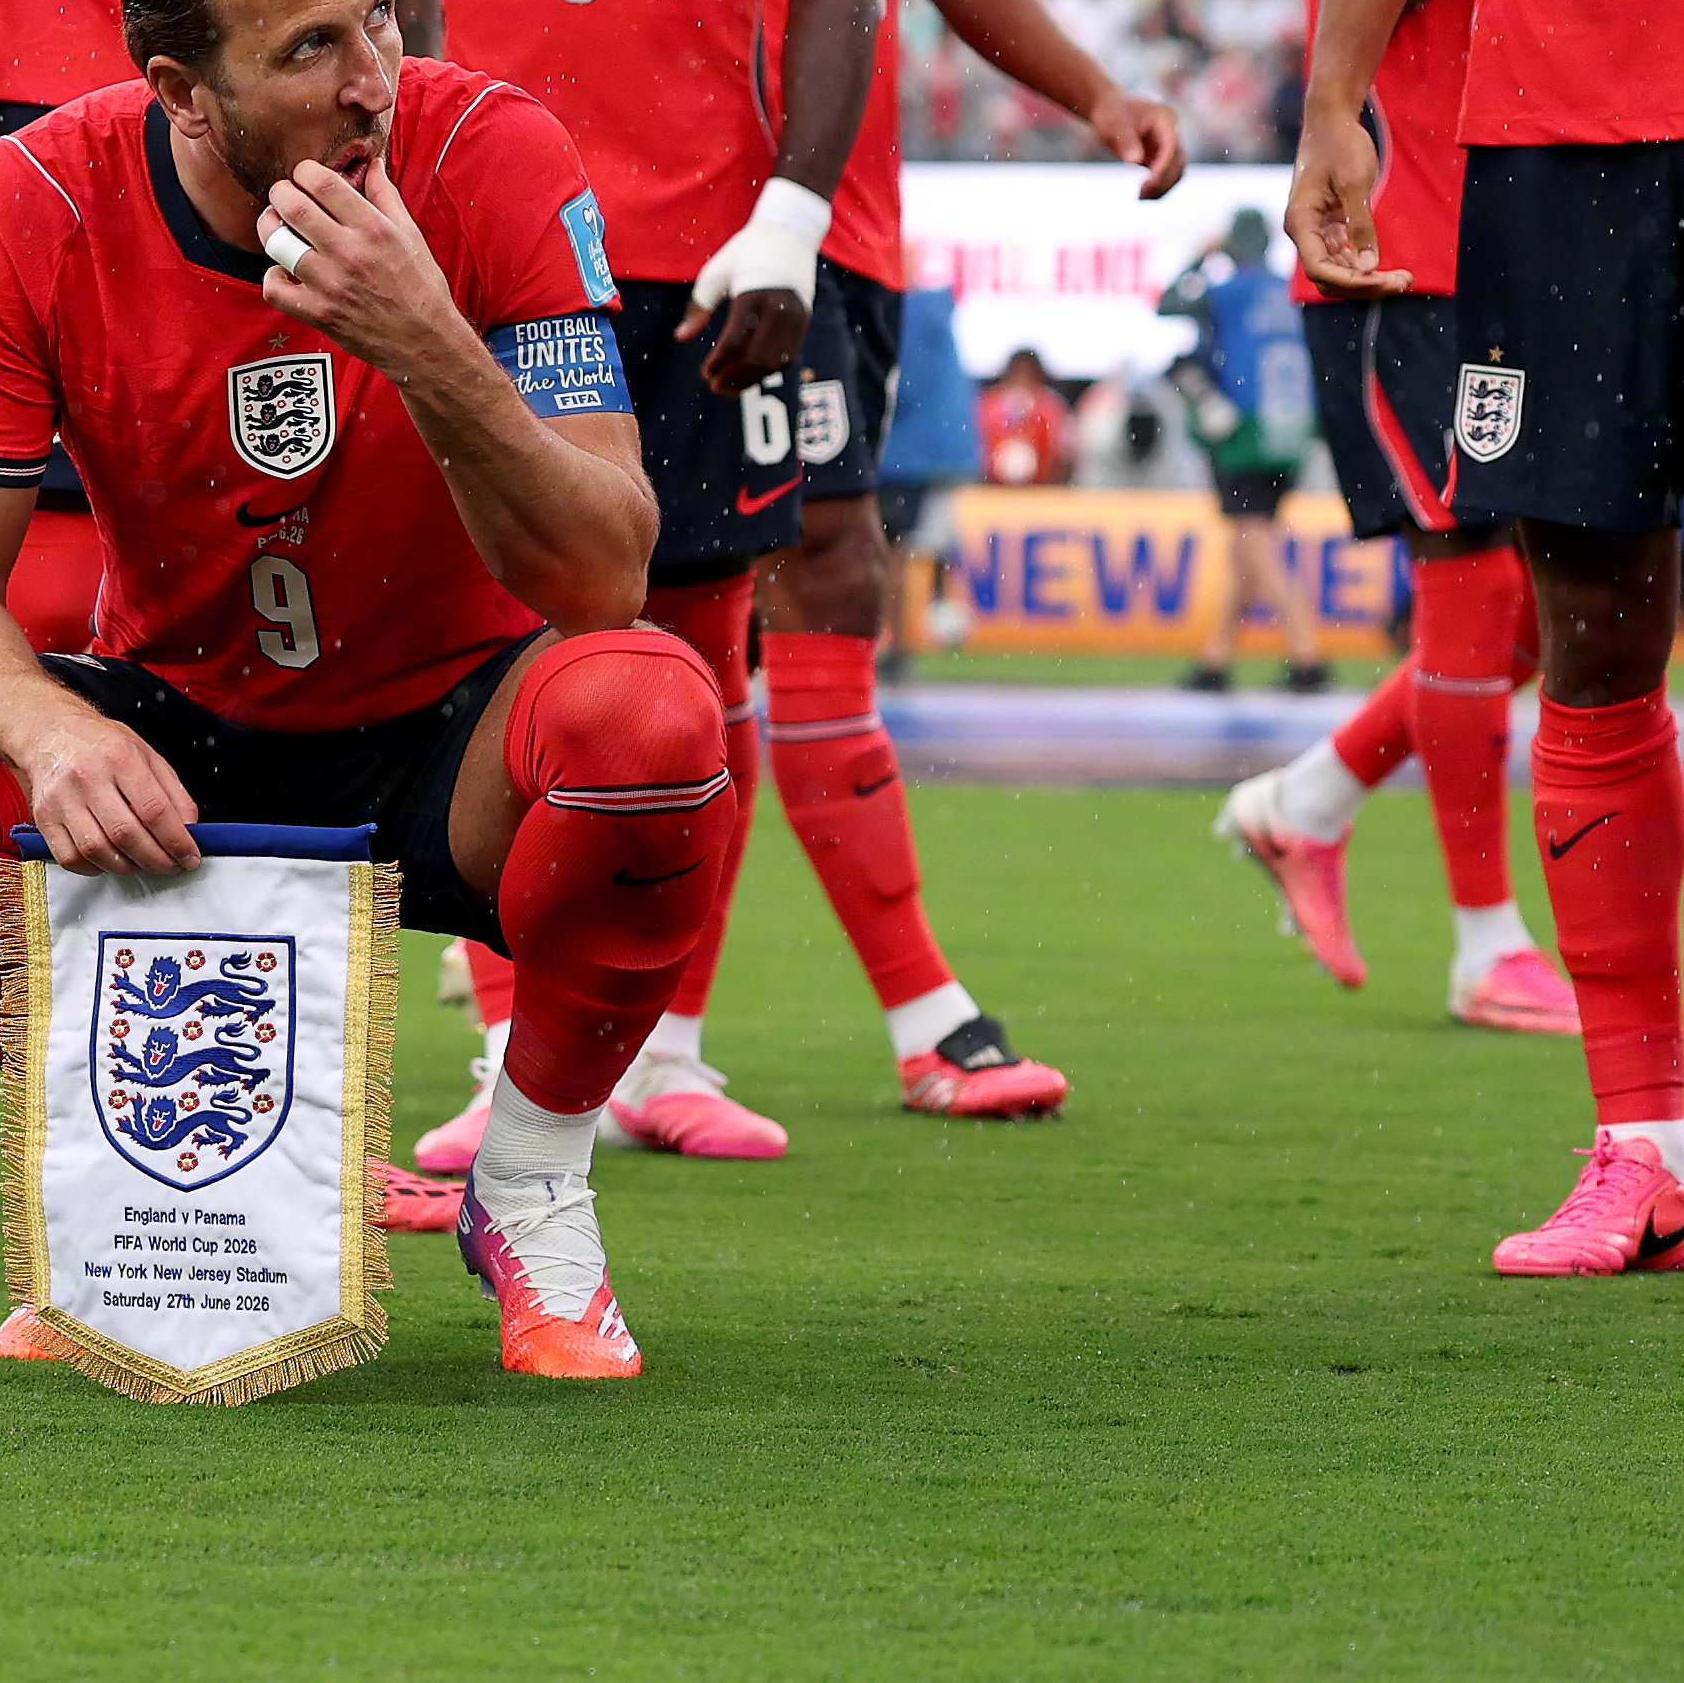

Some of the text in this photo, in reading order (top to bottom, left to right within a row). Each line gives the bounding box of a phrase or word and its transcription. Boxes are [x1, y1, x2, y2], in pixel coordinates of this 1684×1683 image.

[516, 317, 602, 343] FOOTBALL
[517, 336, 606, 370] UNITES
[514, 364, 616, 395] the World
[560, 393, 598, 406] FIFA
[740, 370, 791, 465] 6
[959, 530, 1197, 616] NEW
[250, 553, 321, 670] 9
[124, 1206, 246, 1226] England v Panama
[114, 1234, 257, 1256] FIFA World Cup 2026
[84, 1261, 288, 1285] New York New Jersey Stadium
[103, 1291, 270, 1311] Saturday 27th June 2026
